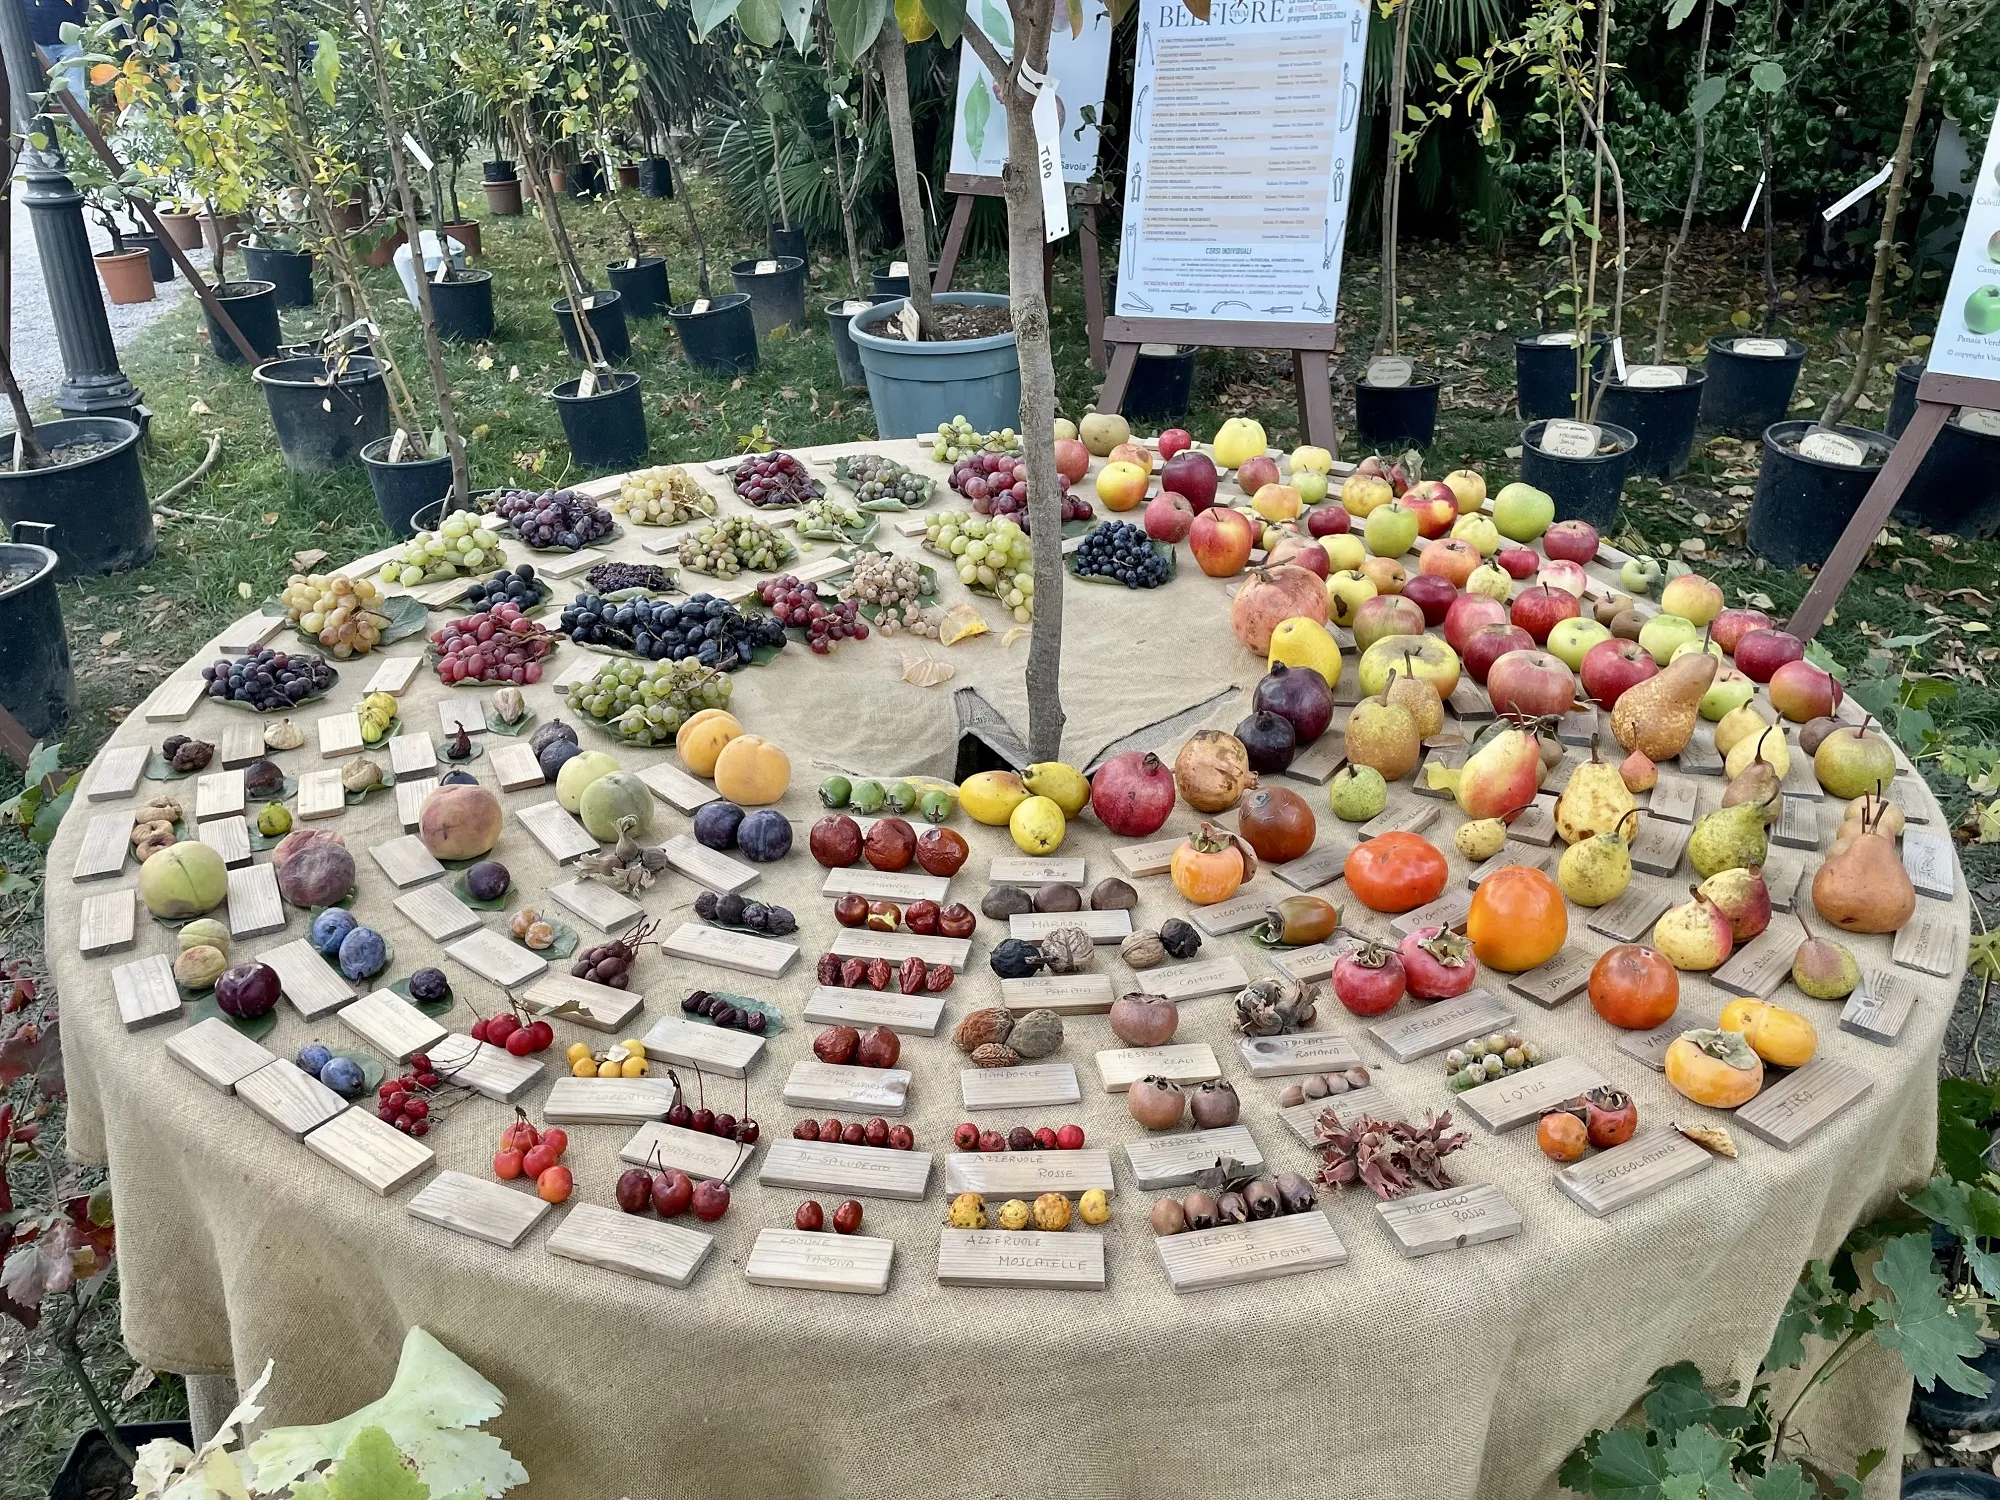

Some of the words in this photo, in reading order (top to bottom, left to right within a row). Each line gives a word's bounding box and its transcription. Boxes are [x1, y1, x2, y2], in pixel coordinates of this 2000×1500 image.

[1287, 15, 1318, 23] programma
[1222, 247, 1252, 255] INDIVIDUALI
[1957, 334, 1981, 344] Panaia
[1955, 351, 1985, 360] copyright
[1553, 447, 1577, 455] ACCO
[1158, 968, 1185, 980] NOCE
[1179, 972, 1226, 986] COMUNE
[1117, 1050, 1166, 1059] NESPOLE
[1295, 1047, 1340, 1059] ROMANA
[1500, 1080, 1546, 1105] LOTUS
[1309, 1100, 1348, 1119] LGA
[1778, 1089, 1814, 1118] JIRO
[973, 1154, 1045, 1164] AZZERUOLE
[1186, 1149, 1238, 1161] COMUNI
[1594, 1142, 1677, 1186] CIOCCOLATINO
[1038, 1168, 1075, 1178] ROSSE
[780, 1236, 832, 1246] COMUNE
[964, 1235, 1042, 1247] AZZERUOLE
[998, 1255, 1088, 1271] MOSCATELLE
[1228, 1246, 1312, 1269] MONTAGNA
